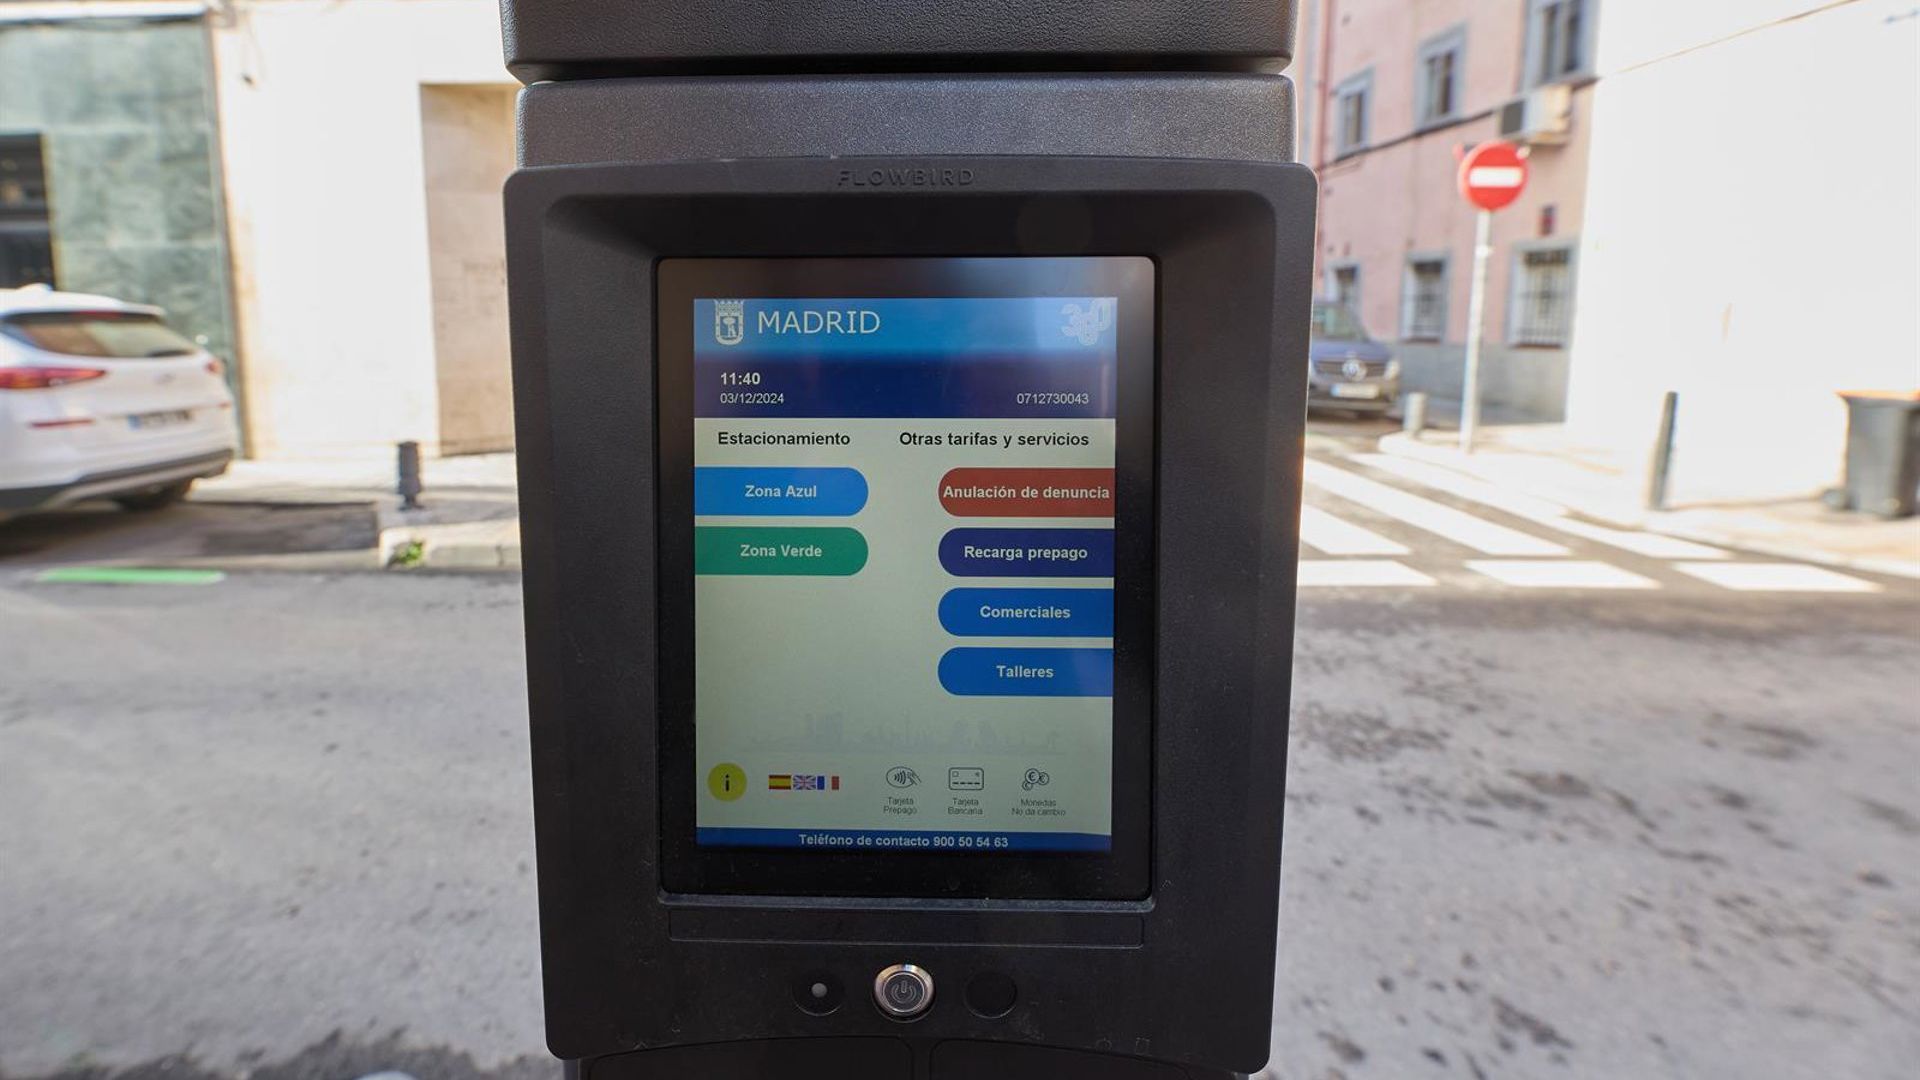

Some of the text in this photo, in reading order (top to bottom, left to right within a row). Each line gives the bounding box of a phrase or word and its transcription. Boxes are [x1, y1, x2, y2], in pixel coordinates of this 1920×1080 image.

[838, 168, 974, 187] FLOWBIRD
[757, 310, 881, 335] MADRID
[720, 372, 761, 386] 11:40
[720, 392, 785, 405] 03/12/2024
[1016, 392, 1090, 405] 0712730043
[717, 431, 851, 446] Estacionamiento
[899, 432, 1090, 449] Otras tarifas y servicios
[744, 484, 817, 498] Zona Azul
[943, 485, 1110, 499] Anulación de denuncia
[740, 544, 823, 558] Zona Verde
[964, 545, 1089, 562] Recarga prepago
[979, 605, 1071, 619] Comerciales
[996, 665, 1055, 678] Talleres
[888, 797, 914, 806] Tarjeta
[952, 798, 979, 807] Tarjeta
[1021, 798, 1057, 807] Monedas
[883, 806, 918, 815] Prepago
[948, 806, 984, 815] Bancaria
[1011, 808, 1067, 816] No da cambio
[799, 833, 1009, 848] Teléfono de contacto 900 50 54 63
